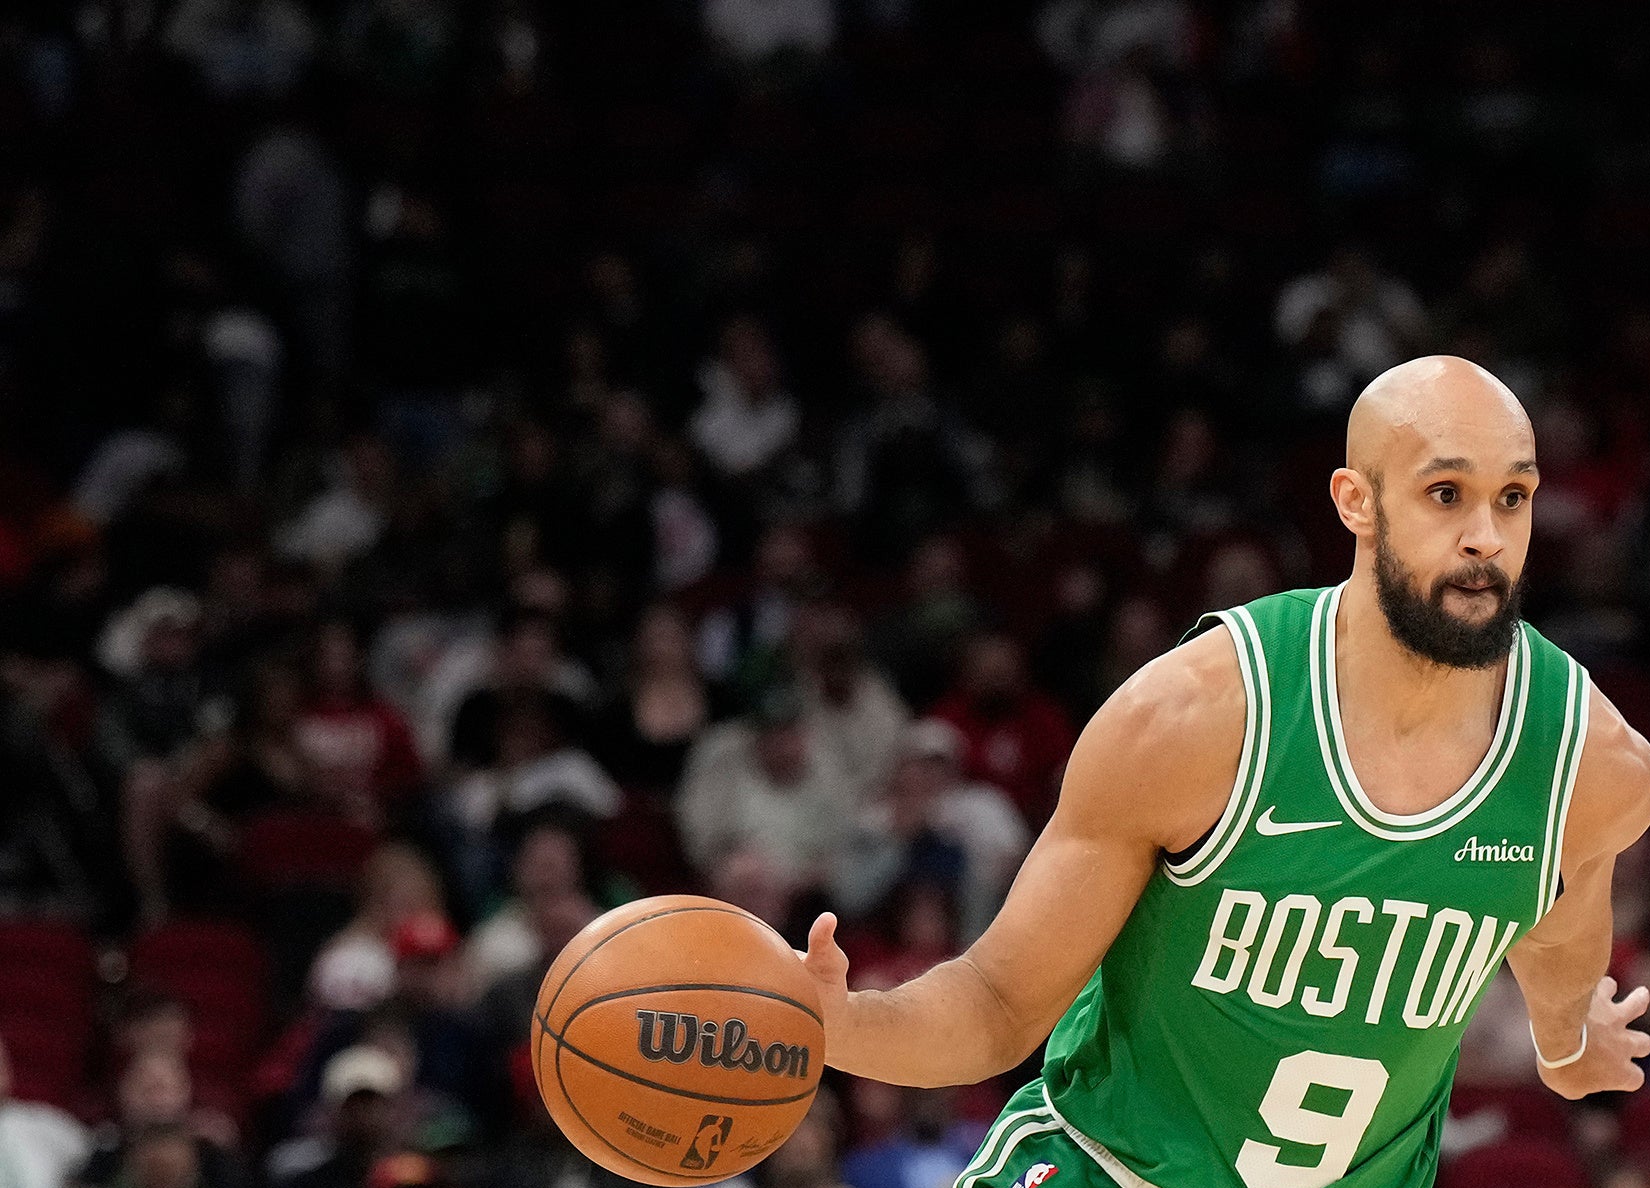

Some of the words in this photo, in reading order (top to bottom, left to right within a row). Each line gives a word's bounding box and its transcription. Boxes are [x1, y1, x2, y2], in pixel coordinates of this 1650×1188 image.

[1454, 836, 1534, 862] Amica
[1191, 889, 1519, 1029] BOSTON
[635, 1009, 810, 1080] Wilson
